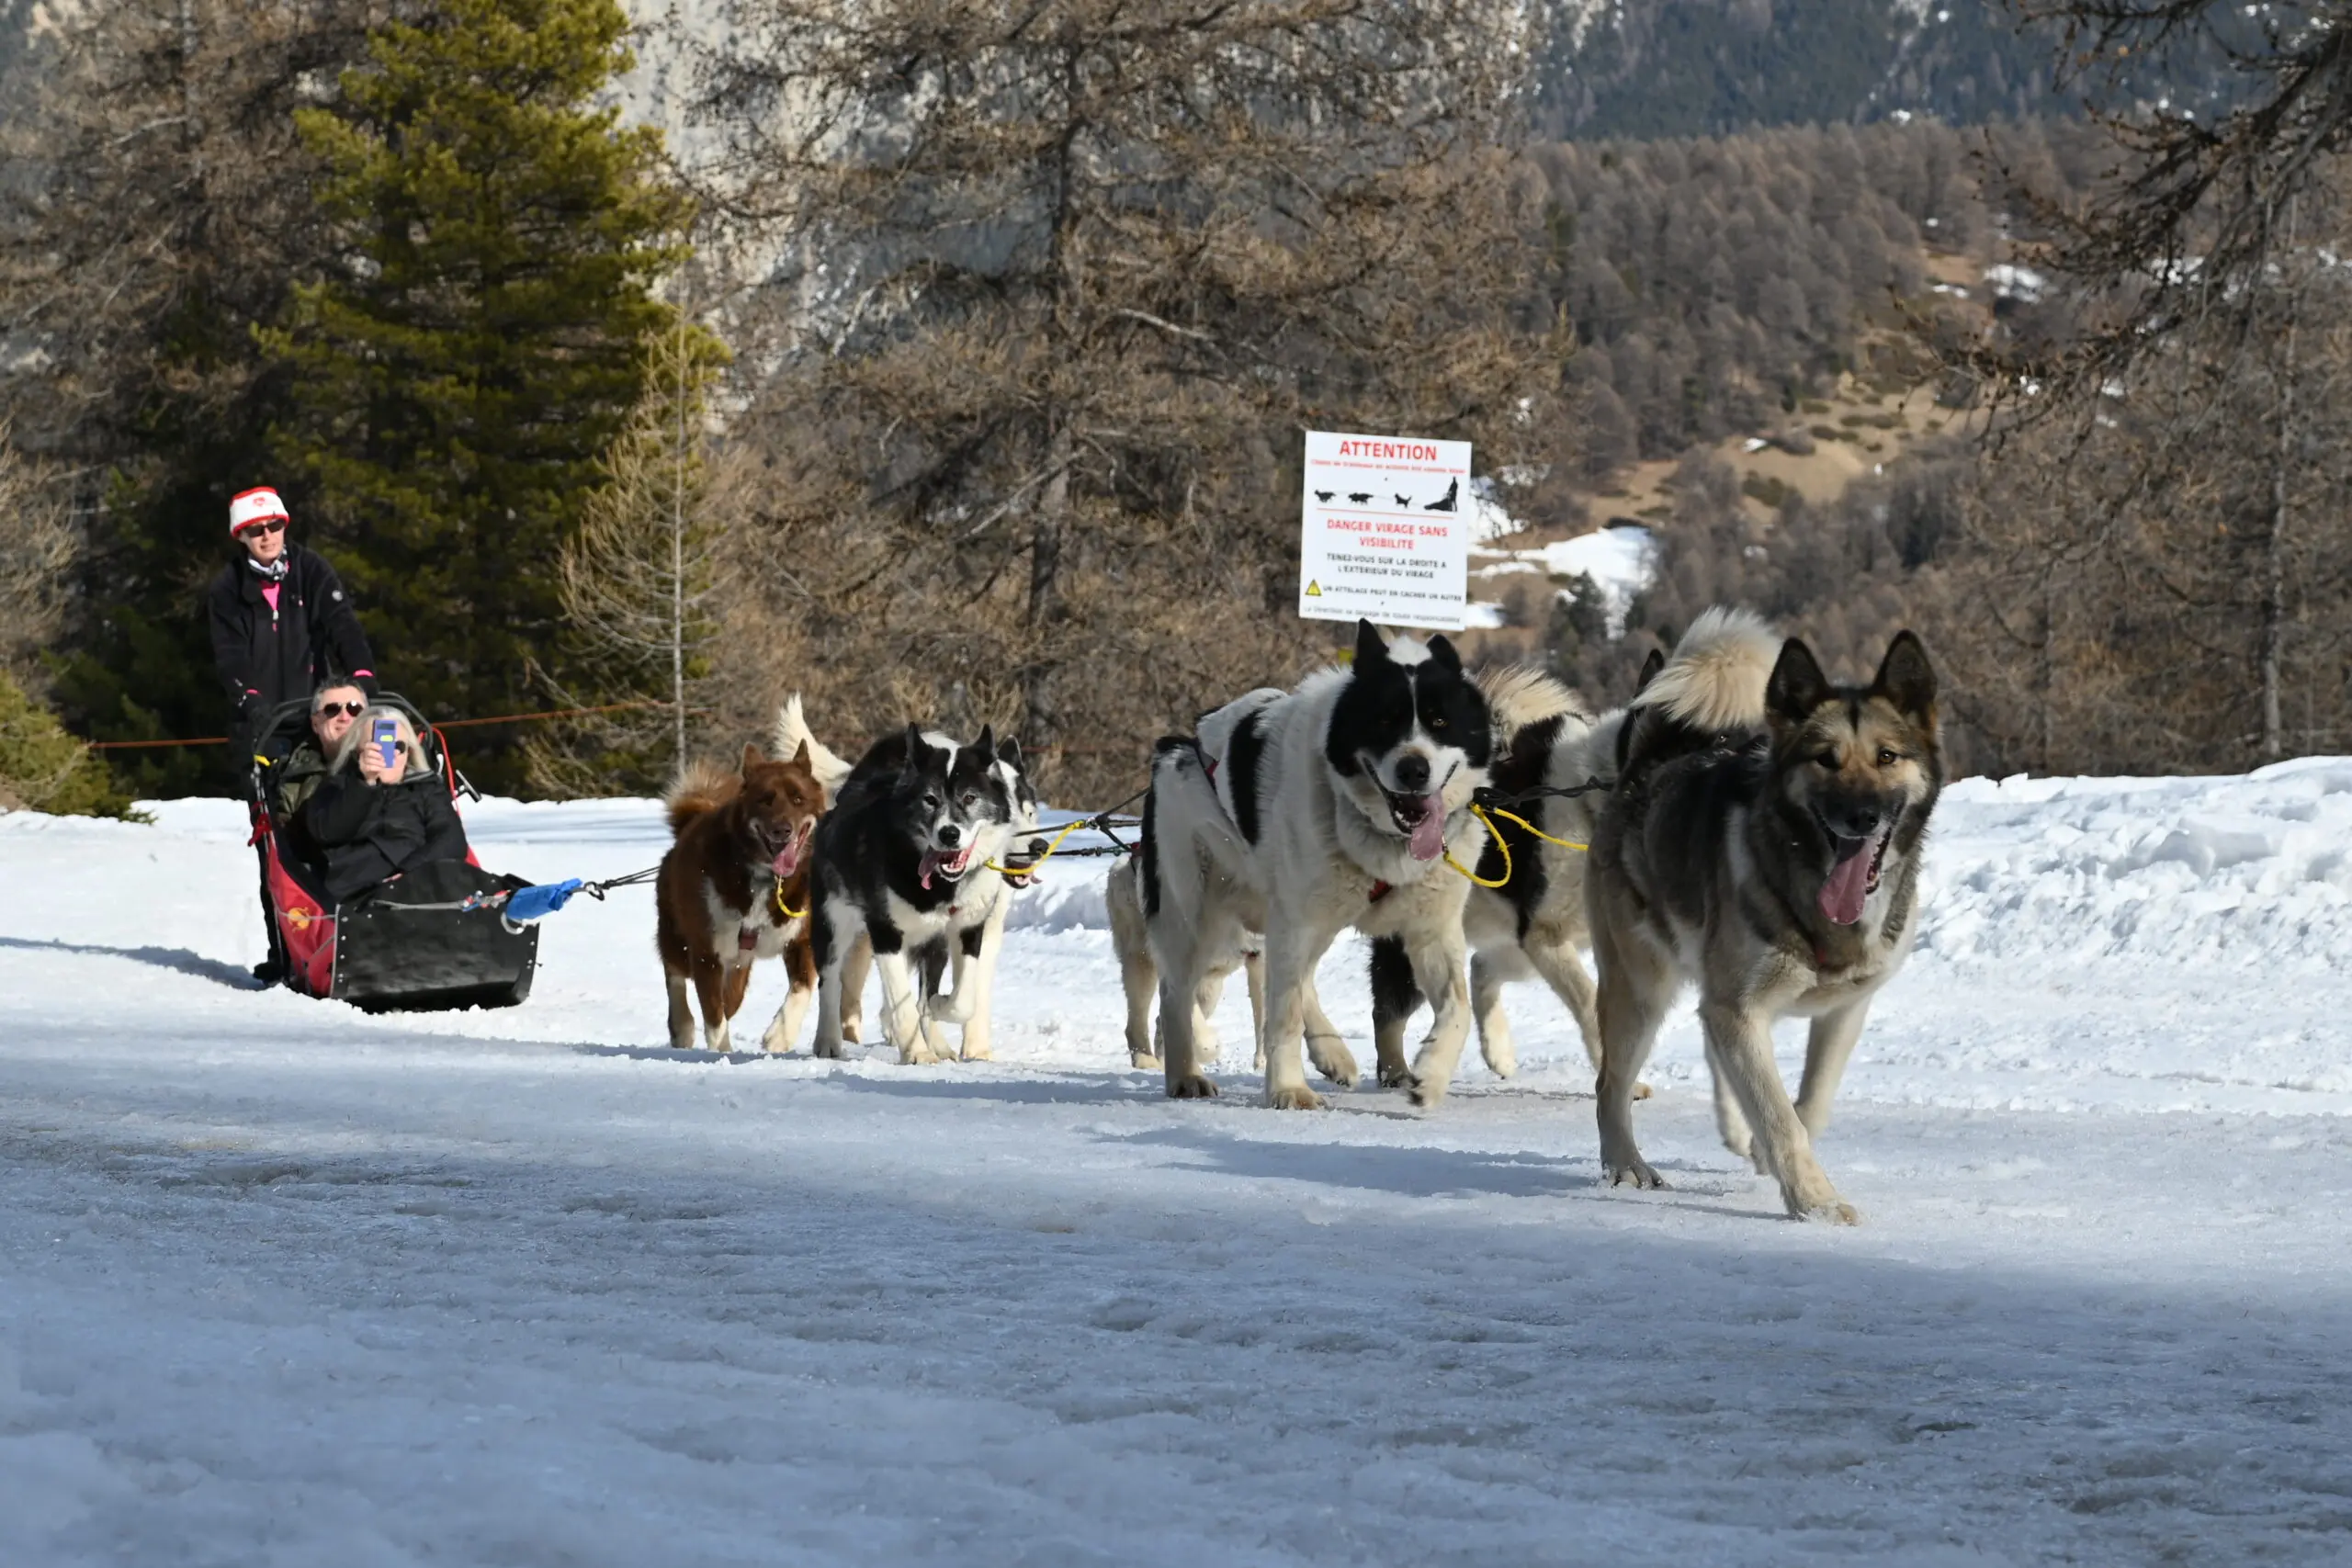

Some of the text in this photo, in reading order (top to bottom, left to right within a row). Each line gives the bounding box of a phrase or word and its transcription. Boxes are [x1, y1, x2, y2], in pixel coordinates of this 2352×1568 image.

[1340, 440, 1438, 460] ATTENTION
[1327, 518, 1448, 537] DANGER VIRAGE SANS
[1396, 558, 1406, 566] LA
[1409, 558, 1438, 568] DROITE
